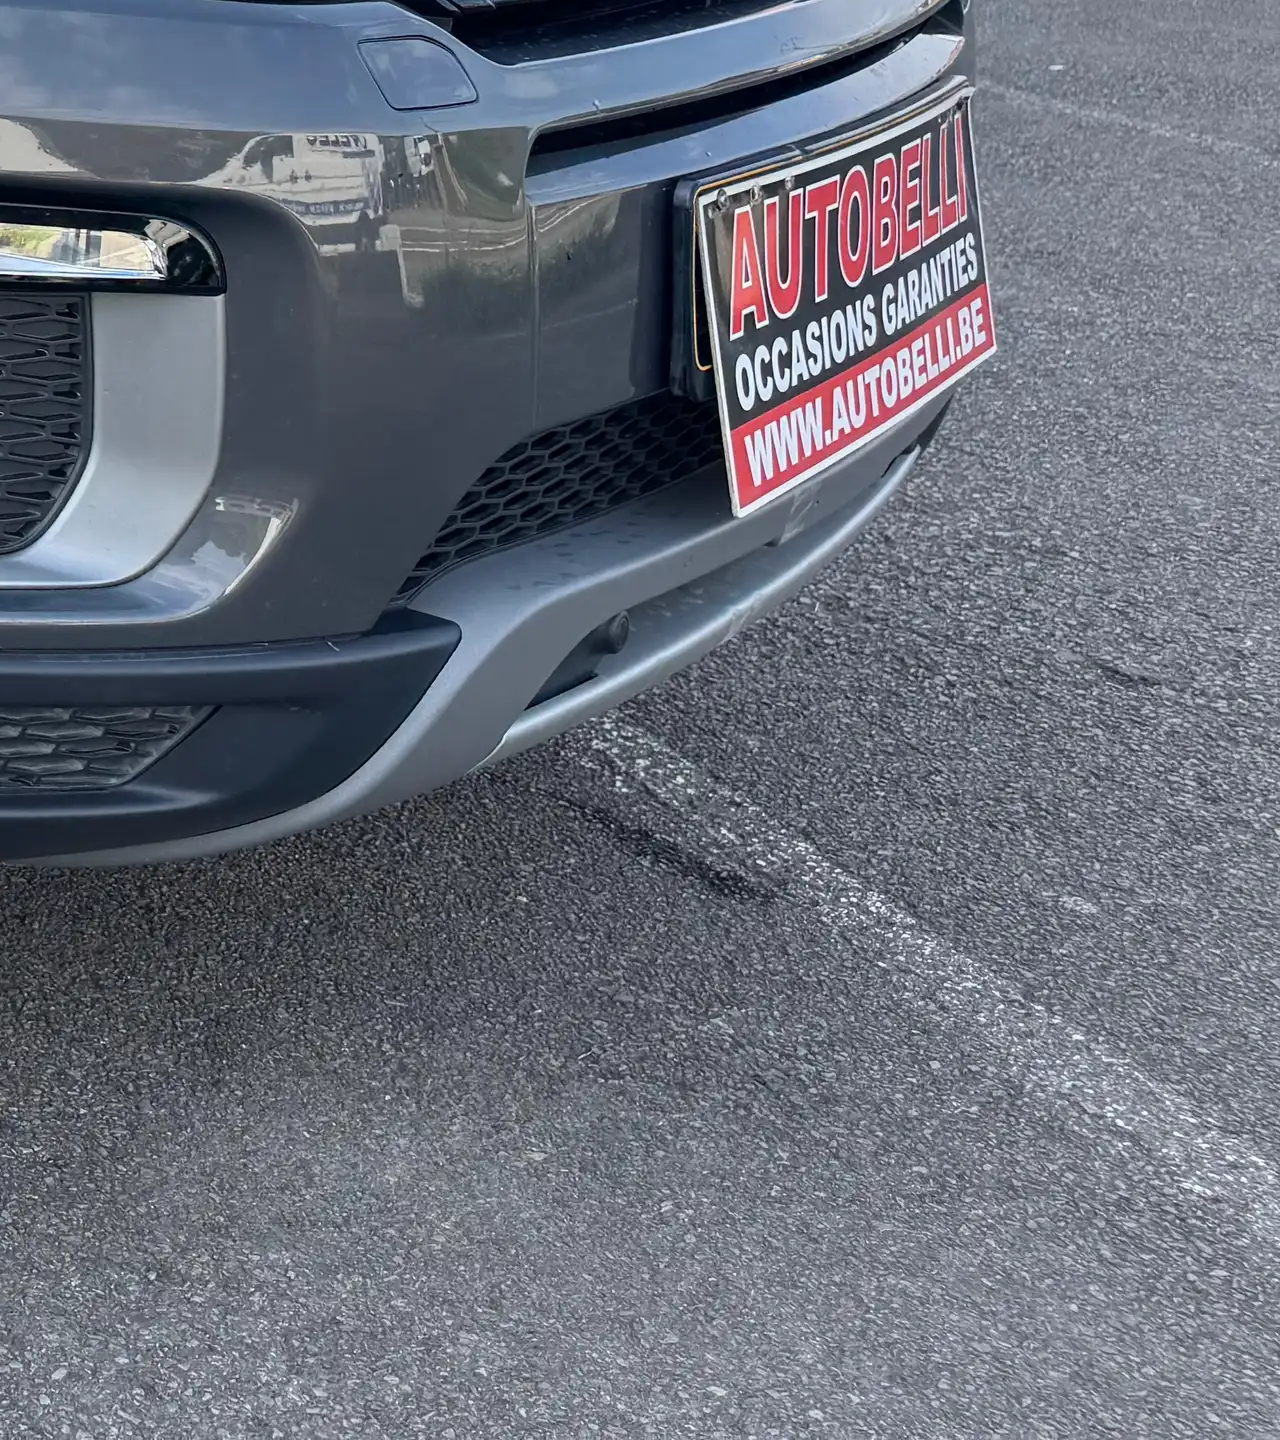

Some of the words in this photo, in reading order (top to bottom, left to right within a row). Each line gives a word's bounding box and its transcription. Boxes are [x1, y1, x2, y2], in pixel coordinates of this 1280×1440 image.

[729, 113, 968, 342] AUTOBELLI
[735, 293, 876, 411] OCCASIONS
[881, 232, 979, 336] GARANTIES
[744, 297, 986, 488] WWW.AUTOBELLI.BE
